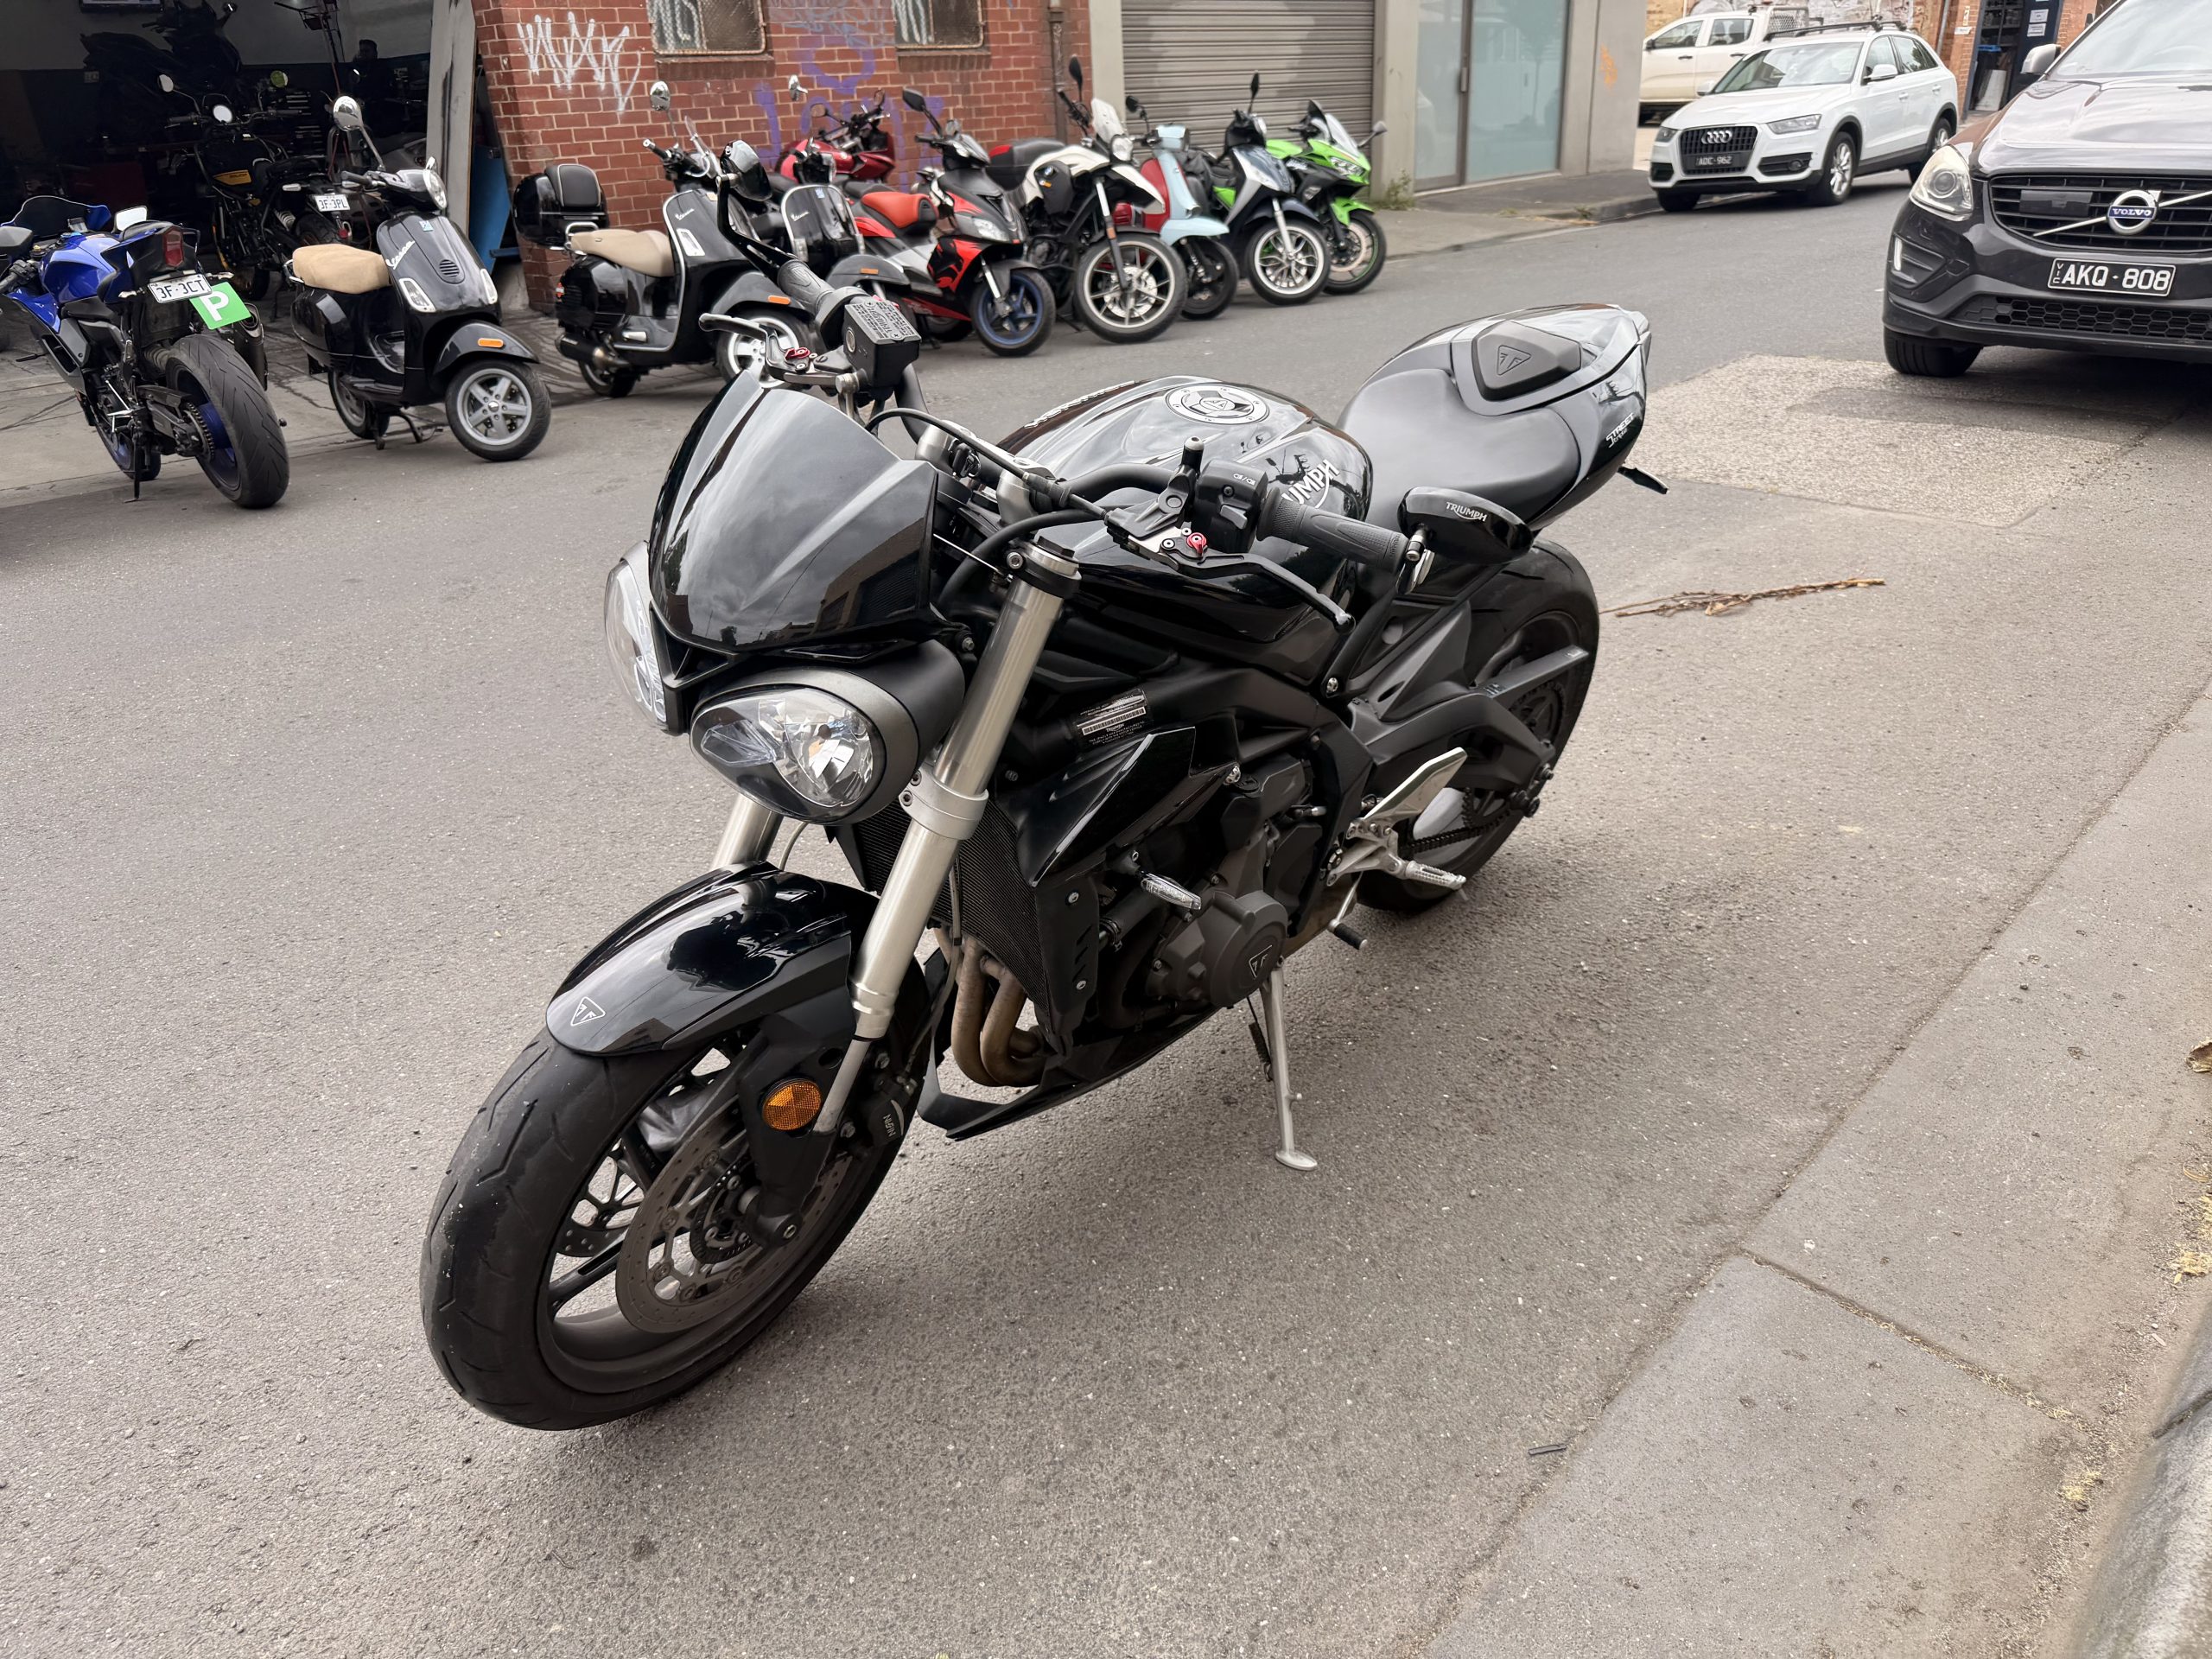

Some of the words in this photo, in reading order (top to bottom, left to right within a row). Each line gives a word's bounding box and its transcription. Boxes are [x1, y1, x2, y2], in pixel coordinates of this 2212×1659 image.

[2062, 264, 2109, 287] AKQ
[2121, 268, 2171, 291] 808
[199, 290, 230, 321] P
[1605, 412, 1634, 448] STREET
[1446, 501, 1488, 522] TRIUMPH
